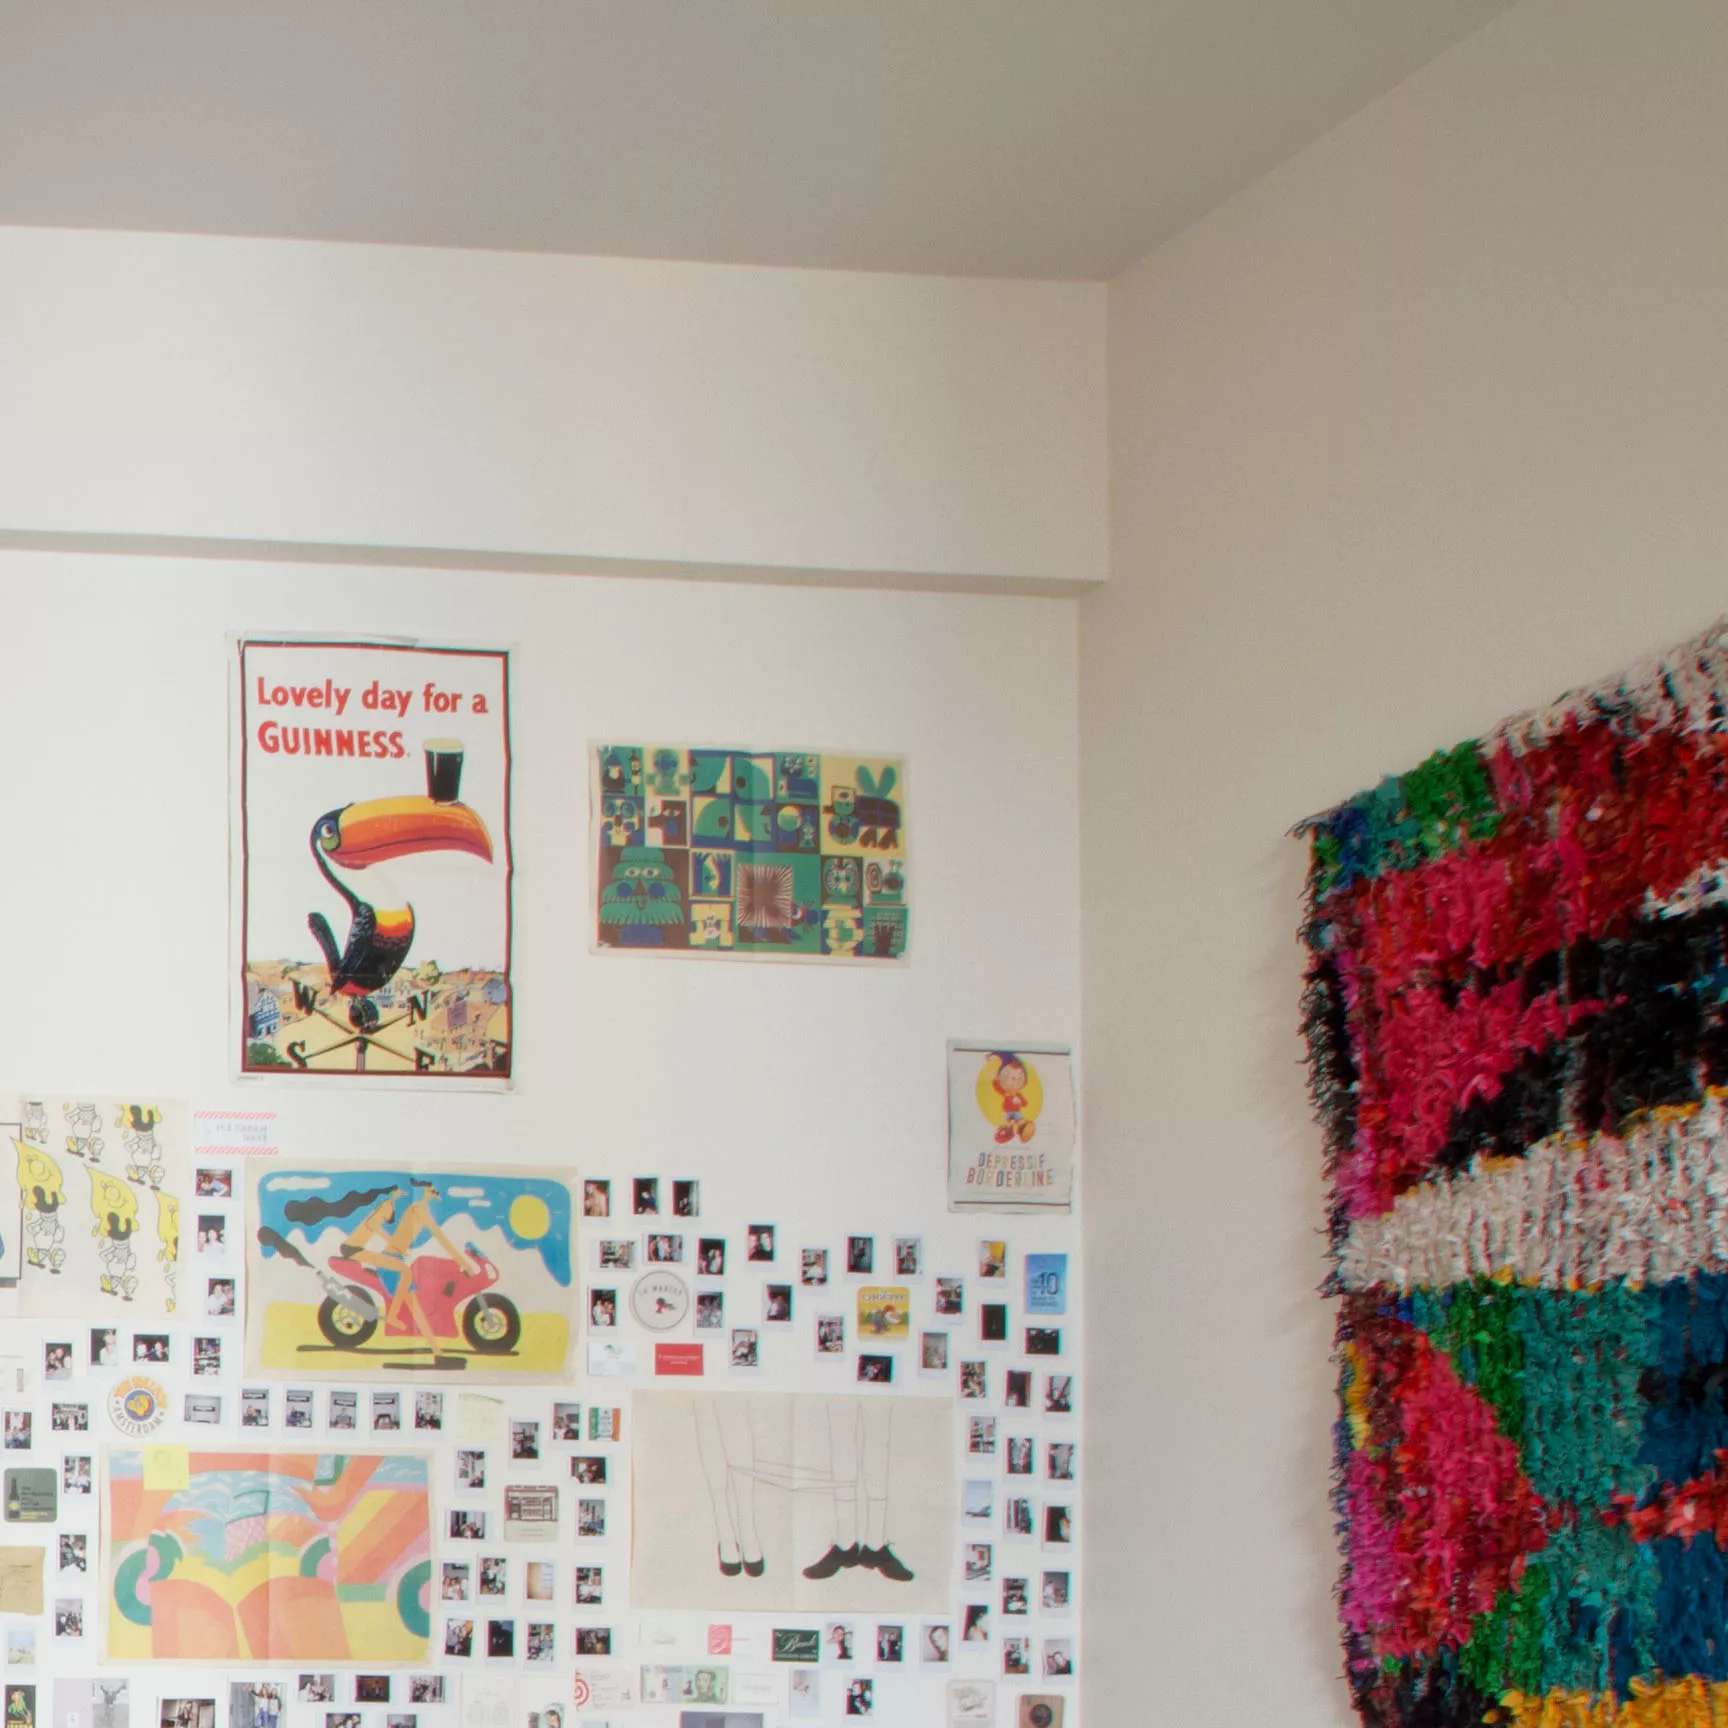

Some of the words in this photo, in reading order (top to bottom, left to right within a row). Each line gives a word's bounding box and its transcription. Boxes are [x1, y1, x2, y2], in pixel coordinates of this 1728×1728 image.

[257, 676, 352, 716] Lovely
[361, 680, 413, 718] day
[422, 682, 463, 713] for
[471, 693, 488, 714] a
[257, 720, 405, 759] GUINNESS
